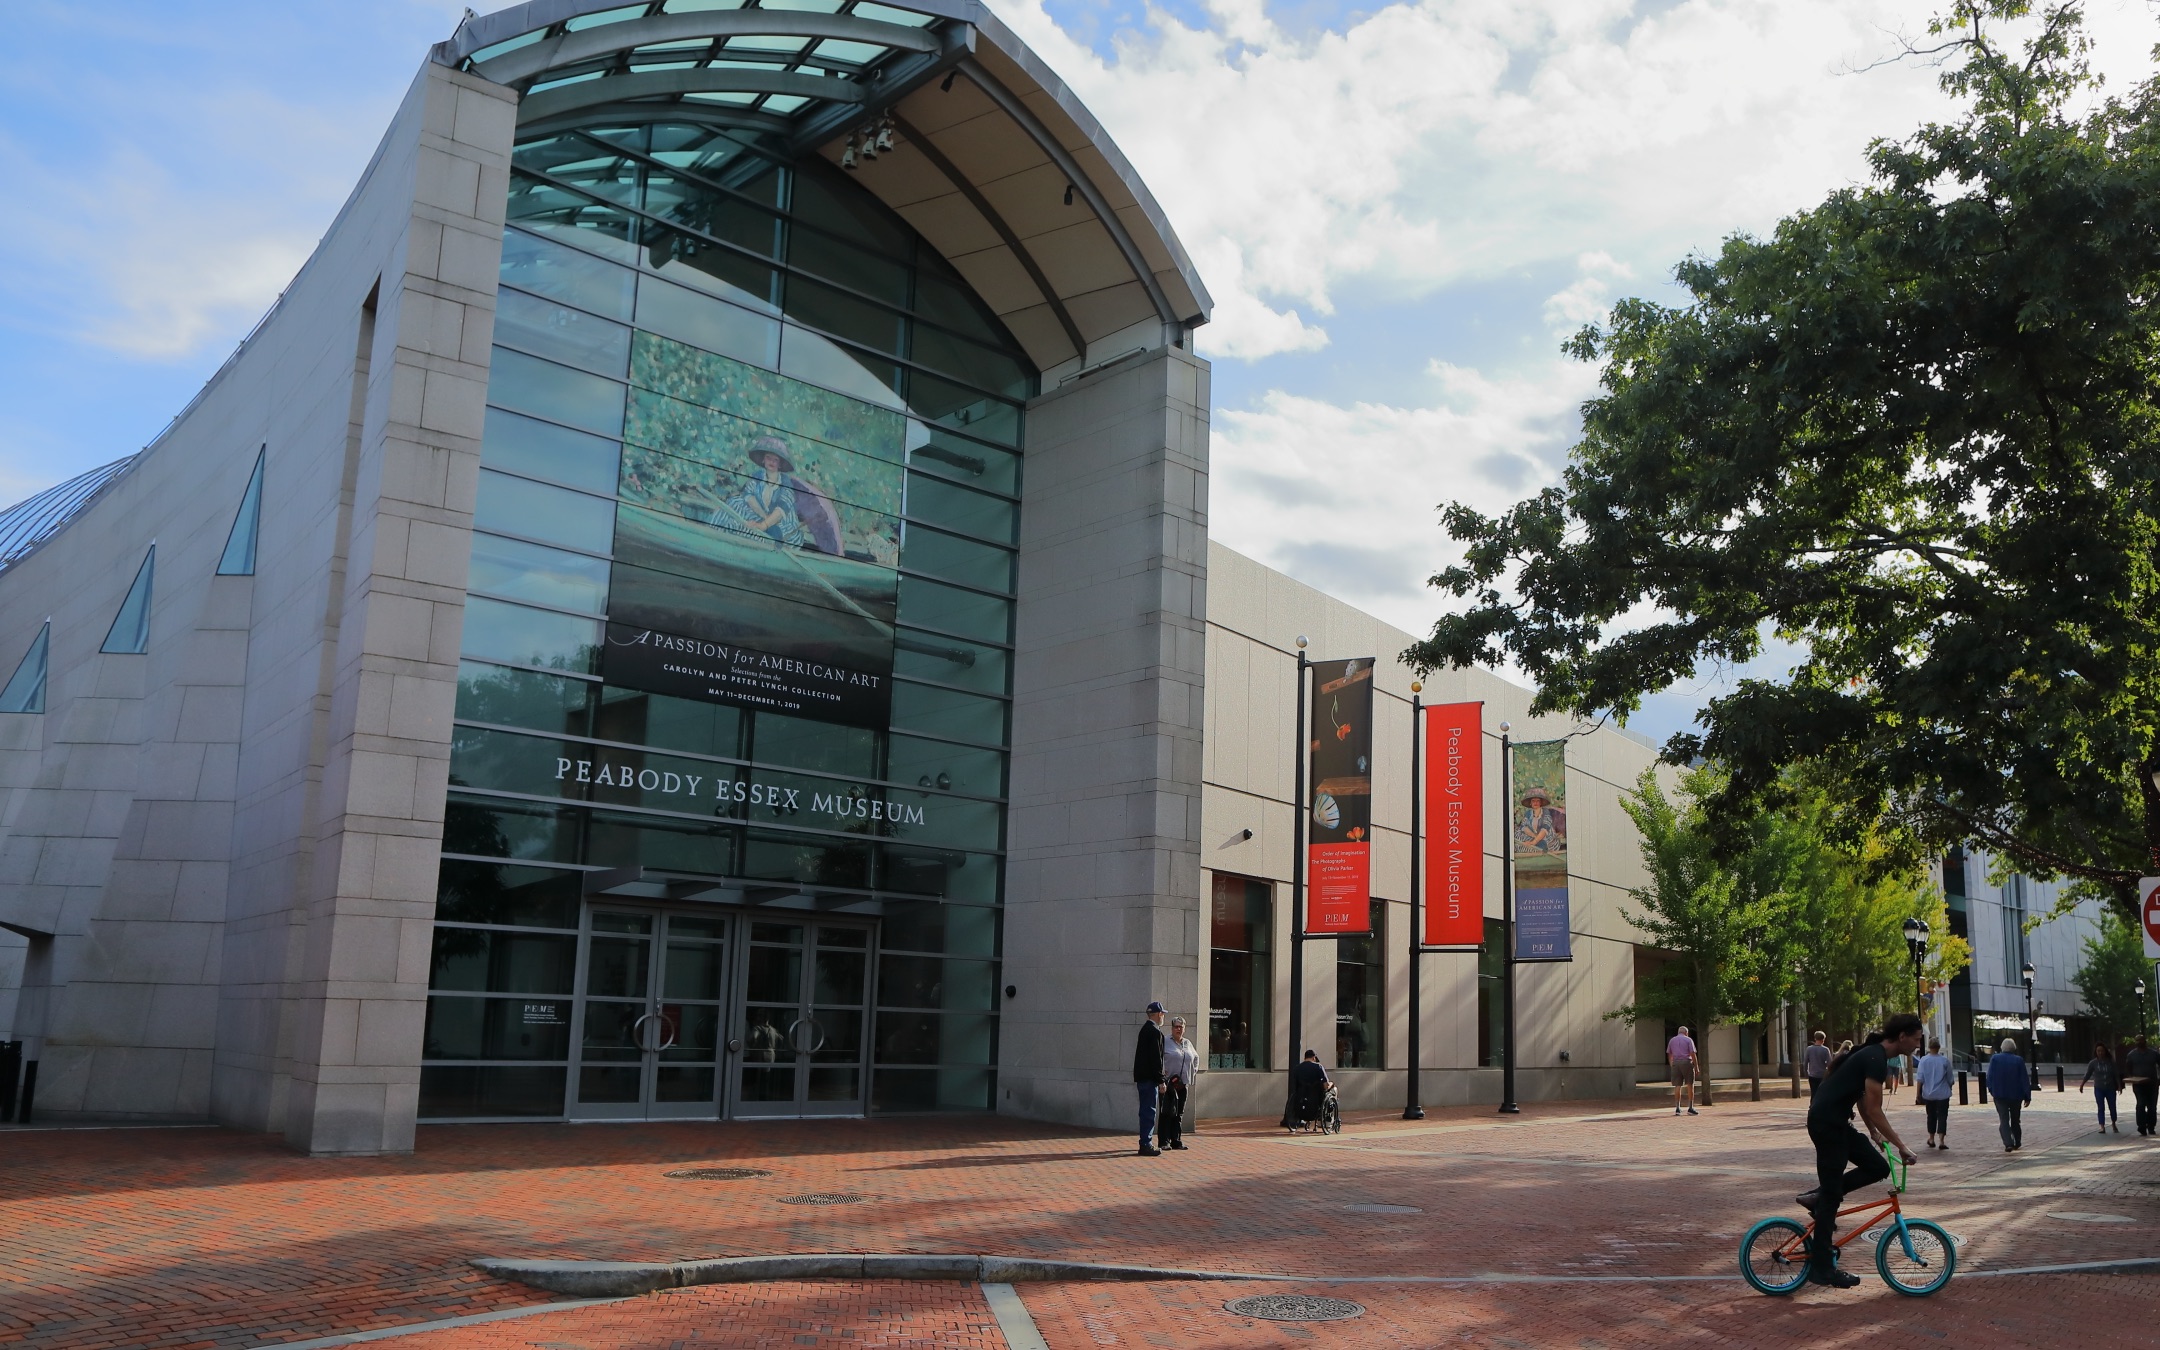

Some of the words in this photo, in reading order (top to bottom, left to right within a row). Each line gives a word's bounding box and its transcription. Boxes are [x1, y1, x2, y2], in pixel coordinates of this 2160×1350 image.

[608, 630, 651, 646] A
[654, 633, 729, 660] PASSION
[733, 650, 755, 664] for
[759, 655, 846, 682] AMERICAN
[850, 673, 880, 688] ART
[663, 663, 705, 677] CAROLYN
[708, 671, 728, 681] AND
[731, 676, 758, 686] PETER
[761, 681, 788, 692] LYNCH
[791, 687, 842, 702] COLLECTION
[731, 666, 758, 677] Selections
[758, 671, 772, 681] from
[708, 688, 725, 697] MAY
[785, 701, 801, 710] 2019
[1445, 727, 1463, 797] Peabody
[555, 757, 703, 797] PEABODY
[716, 779, 801, 810] ESSEX
[811, 792, 925, 825] MUSEUM
[1448, 801, 1463, 844] Essex
[1448, 849, 1463, 919] Museum
